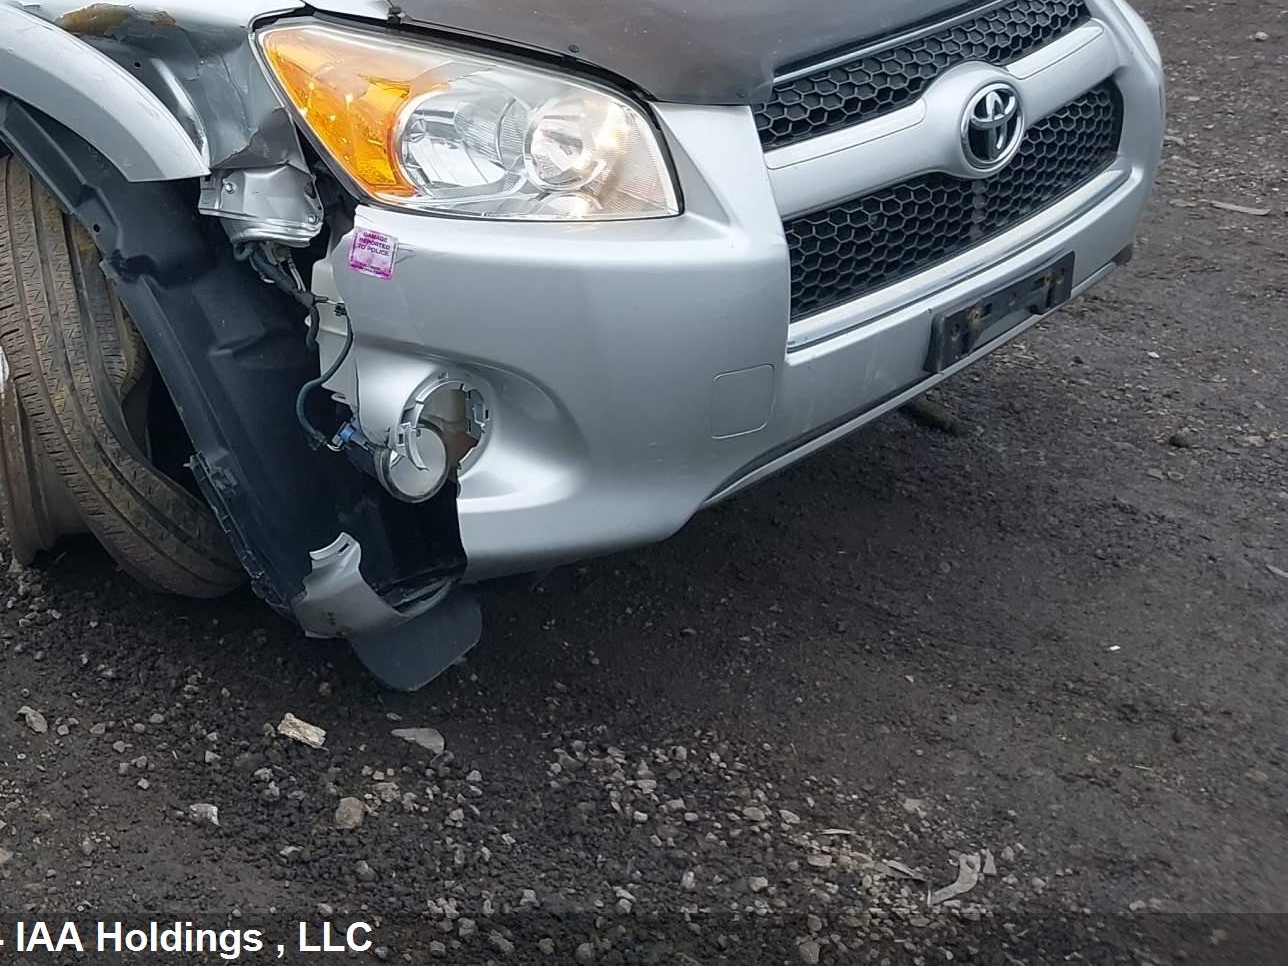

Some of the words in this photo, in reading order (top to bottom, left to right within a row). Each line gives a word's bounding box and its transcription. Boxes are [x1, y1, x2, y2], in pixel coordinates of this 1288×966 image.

[363, 232, 388, 242] DAMAGE
[359, 237, 391, 249] REPORTED
[367, 245, 390, 256] POLICE
